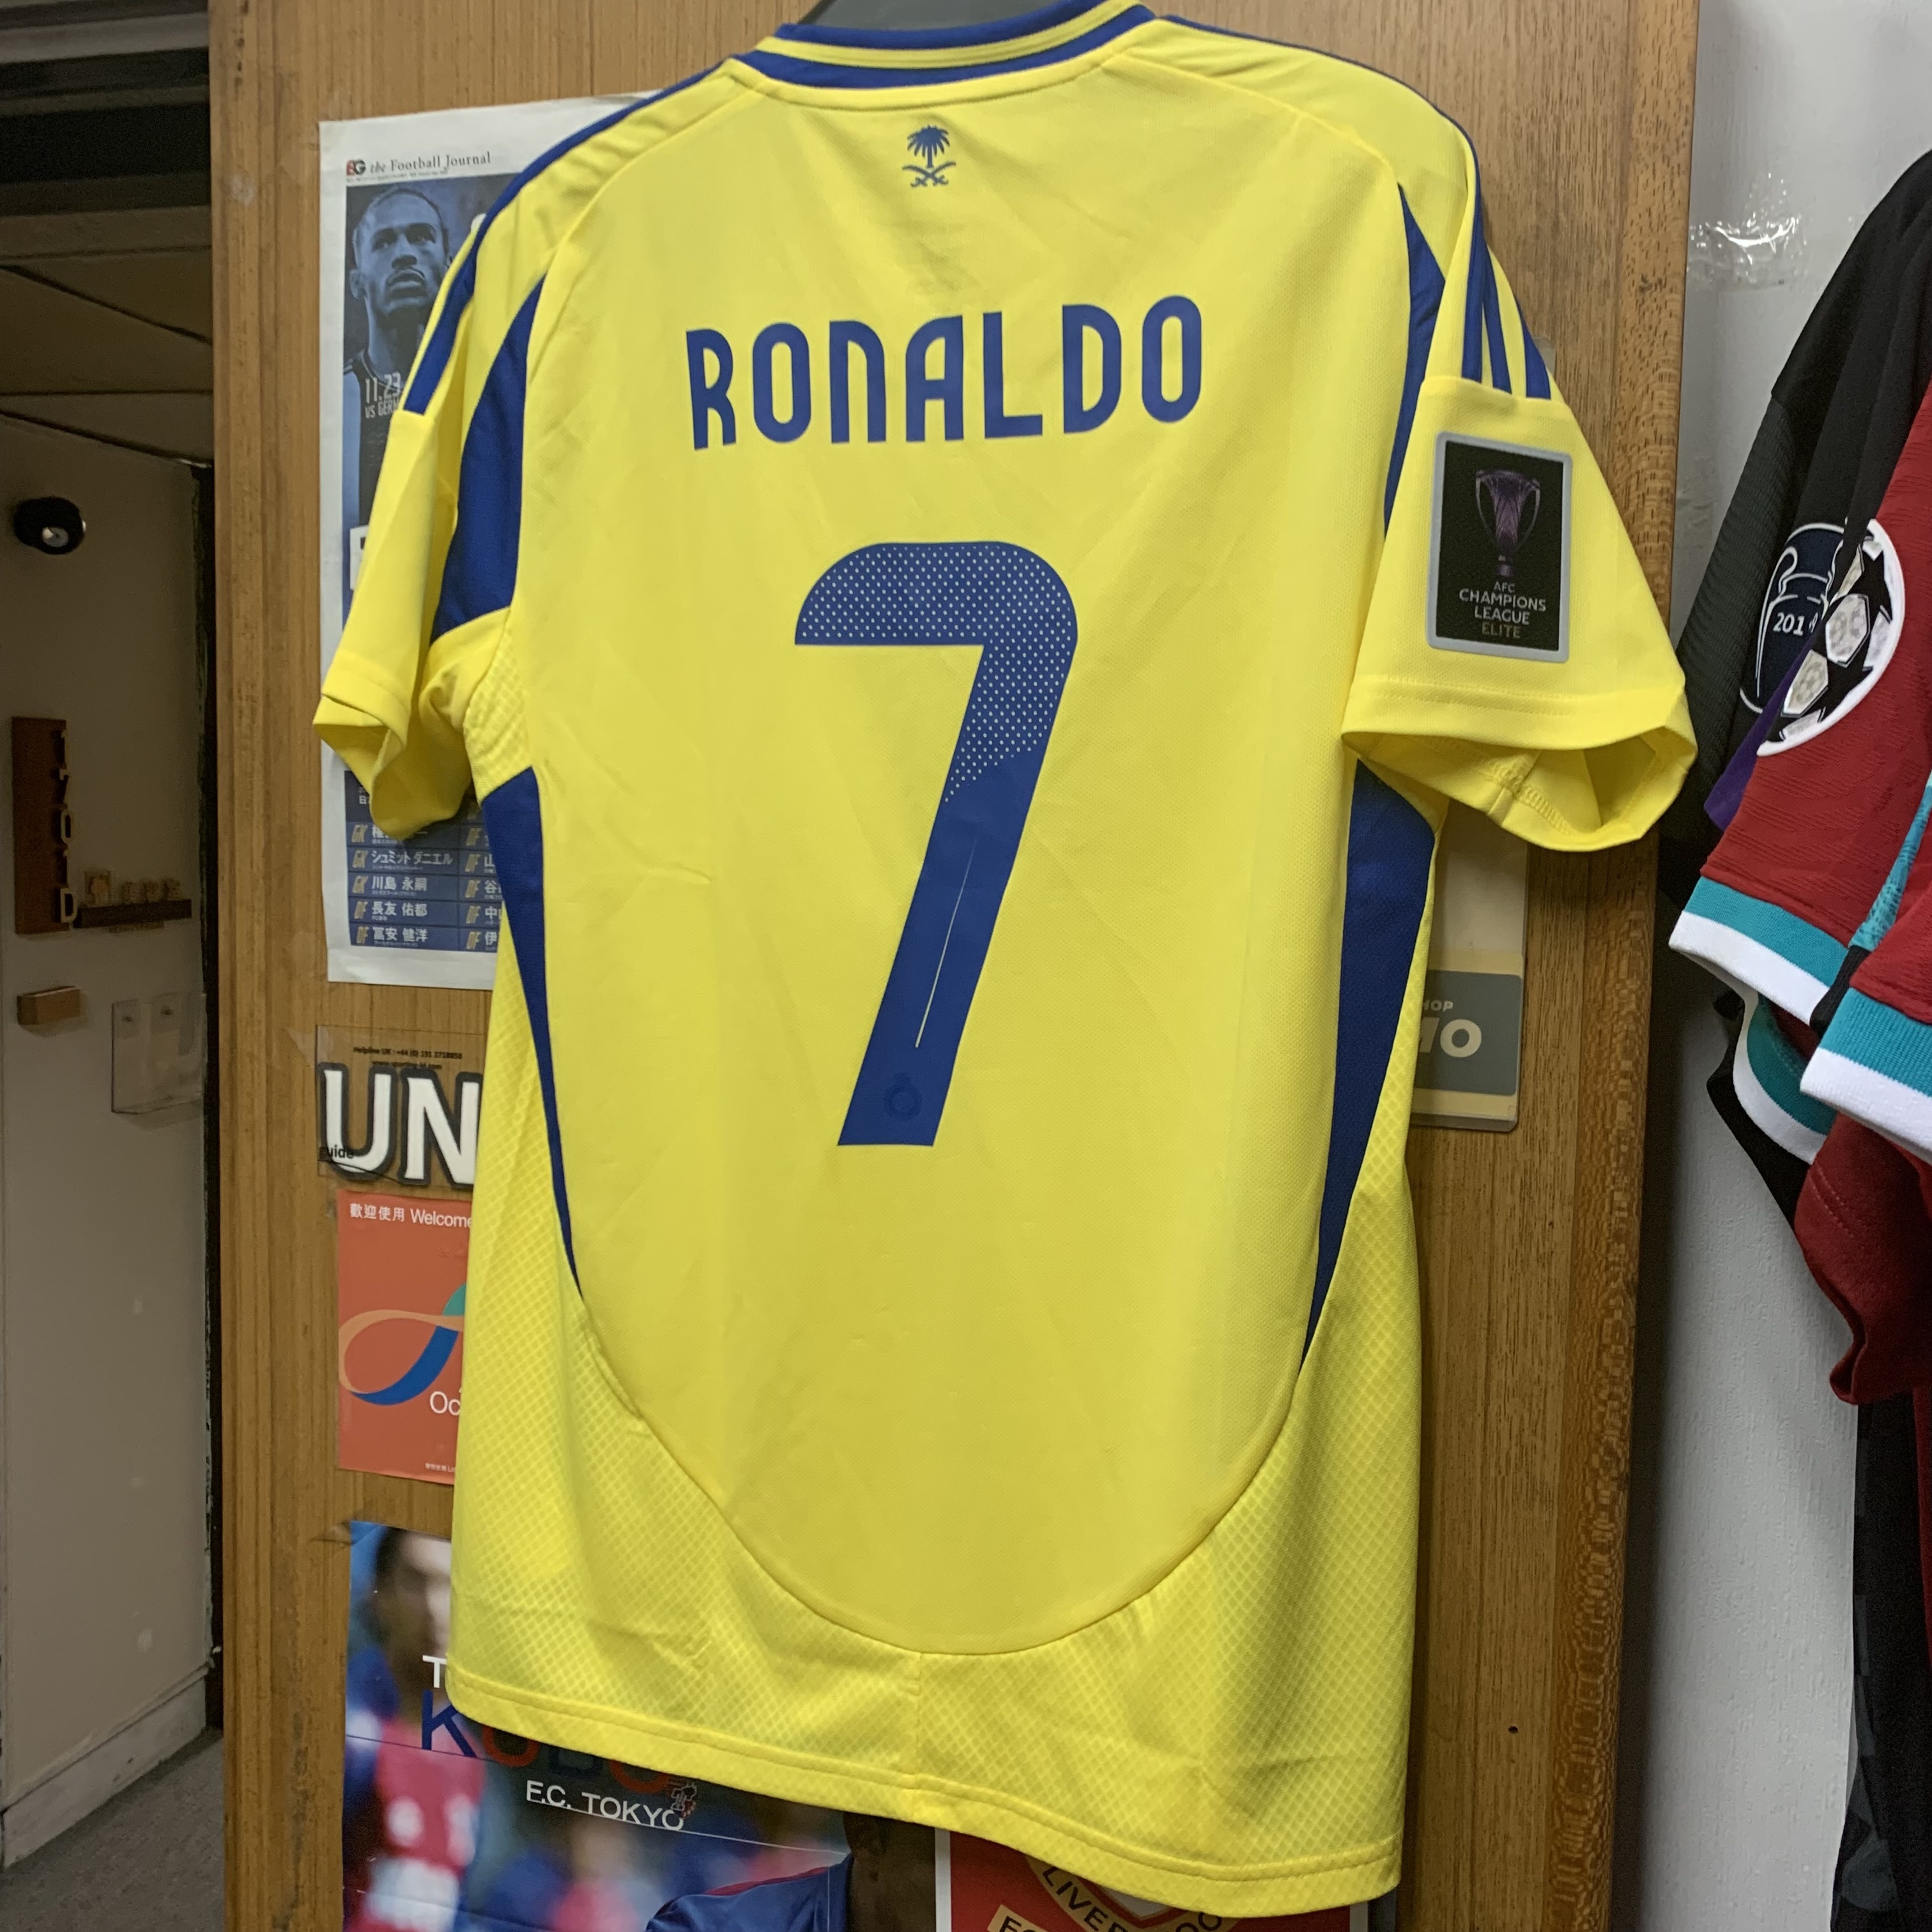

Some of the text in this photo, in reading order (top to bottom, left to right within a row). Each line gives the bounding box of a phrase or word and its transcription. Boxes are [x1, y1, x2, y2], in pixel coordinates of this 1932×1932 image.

[370, 161, 386, 173] the
[391, 155, 440, 171] Football
[444, 151, 491, 172] Journal
[686, 295, 1201, 450] RONALDO
[365, 372, 401, 404] 11.23
[365, 405, 376, 419] VS
[1494, 581, 1515, 593] AFC
[1459, 588, 1546, 612] CHAMPIONS
[1475, 605, 1530, 625] LEAGUE
[1482, 621, 1521, 638] ELITE
[795, 541, 1077, 1146] 7
[372, 850, 411, 864] シュミット
[414, 851, 453, 865] ダニエル
[372, 876, 397, 890] 川島
[484, 880, 502, 894] 谷
[372, 901, 397, 916] 長友
[402, 903, 427, 917] 佑都
[485, 906, 502, 920] 中
[319, 1063, 482, 1191] UN
[349, 1203, 405, 1223] 歡迎使用
[526, 1779, 684, 1832] F.C. TOKYO
